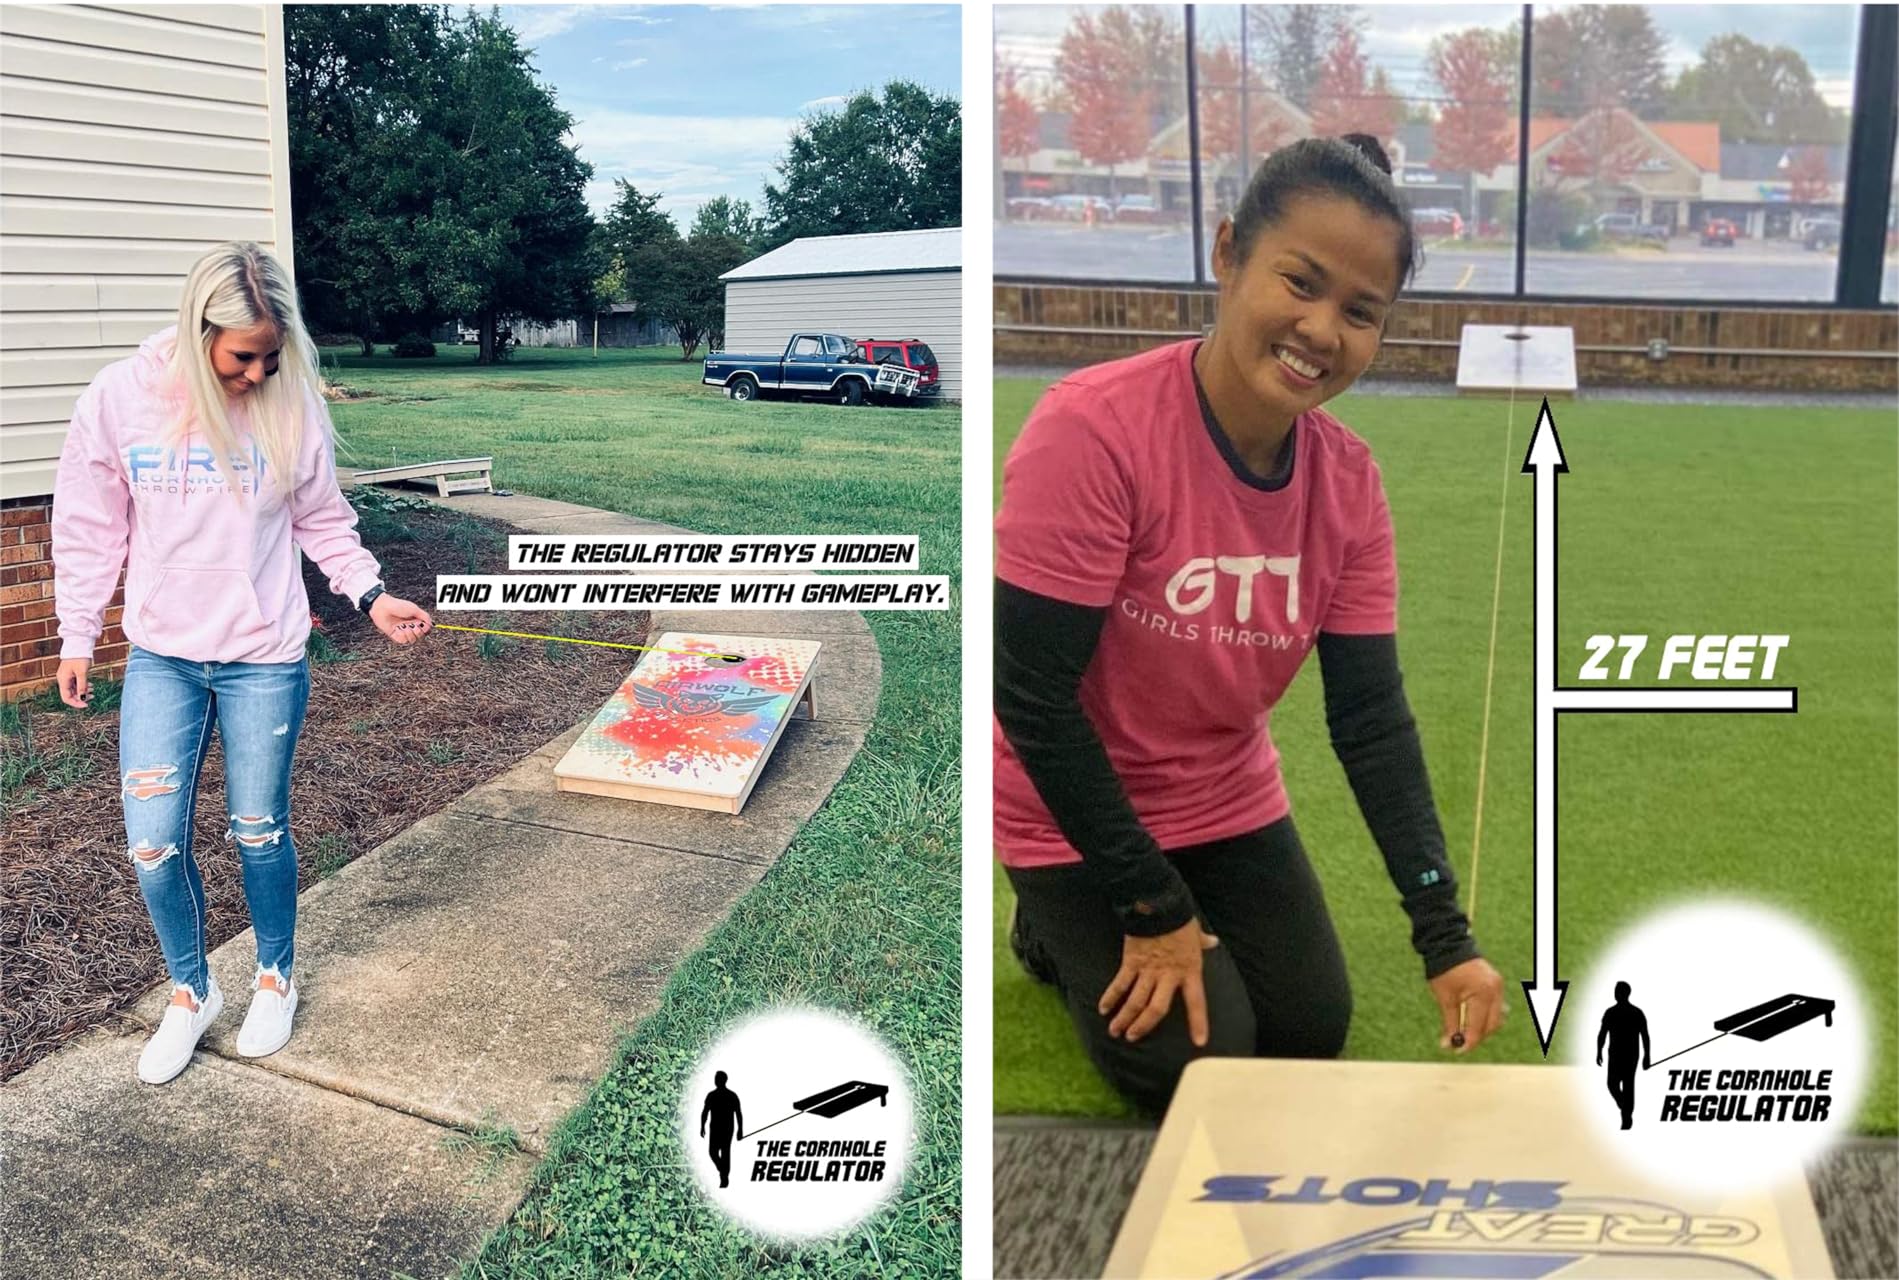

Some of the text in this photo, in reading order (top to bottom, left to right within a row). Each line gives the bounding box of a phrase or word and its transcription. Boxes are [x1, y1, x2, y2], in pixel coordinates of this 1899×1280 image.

[1122, 598, 1199, 641] GIRLS
[1210, 625, 1294, 651] THROW
[654, 680, 766, 696] AIRWOLF
[1191, 1175, 1571, 1211] SHOTS
[1399, 1209, 1762, 1246] GREAT
